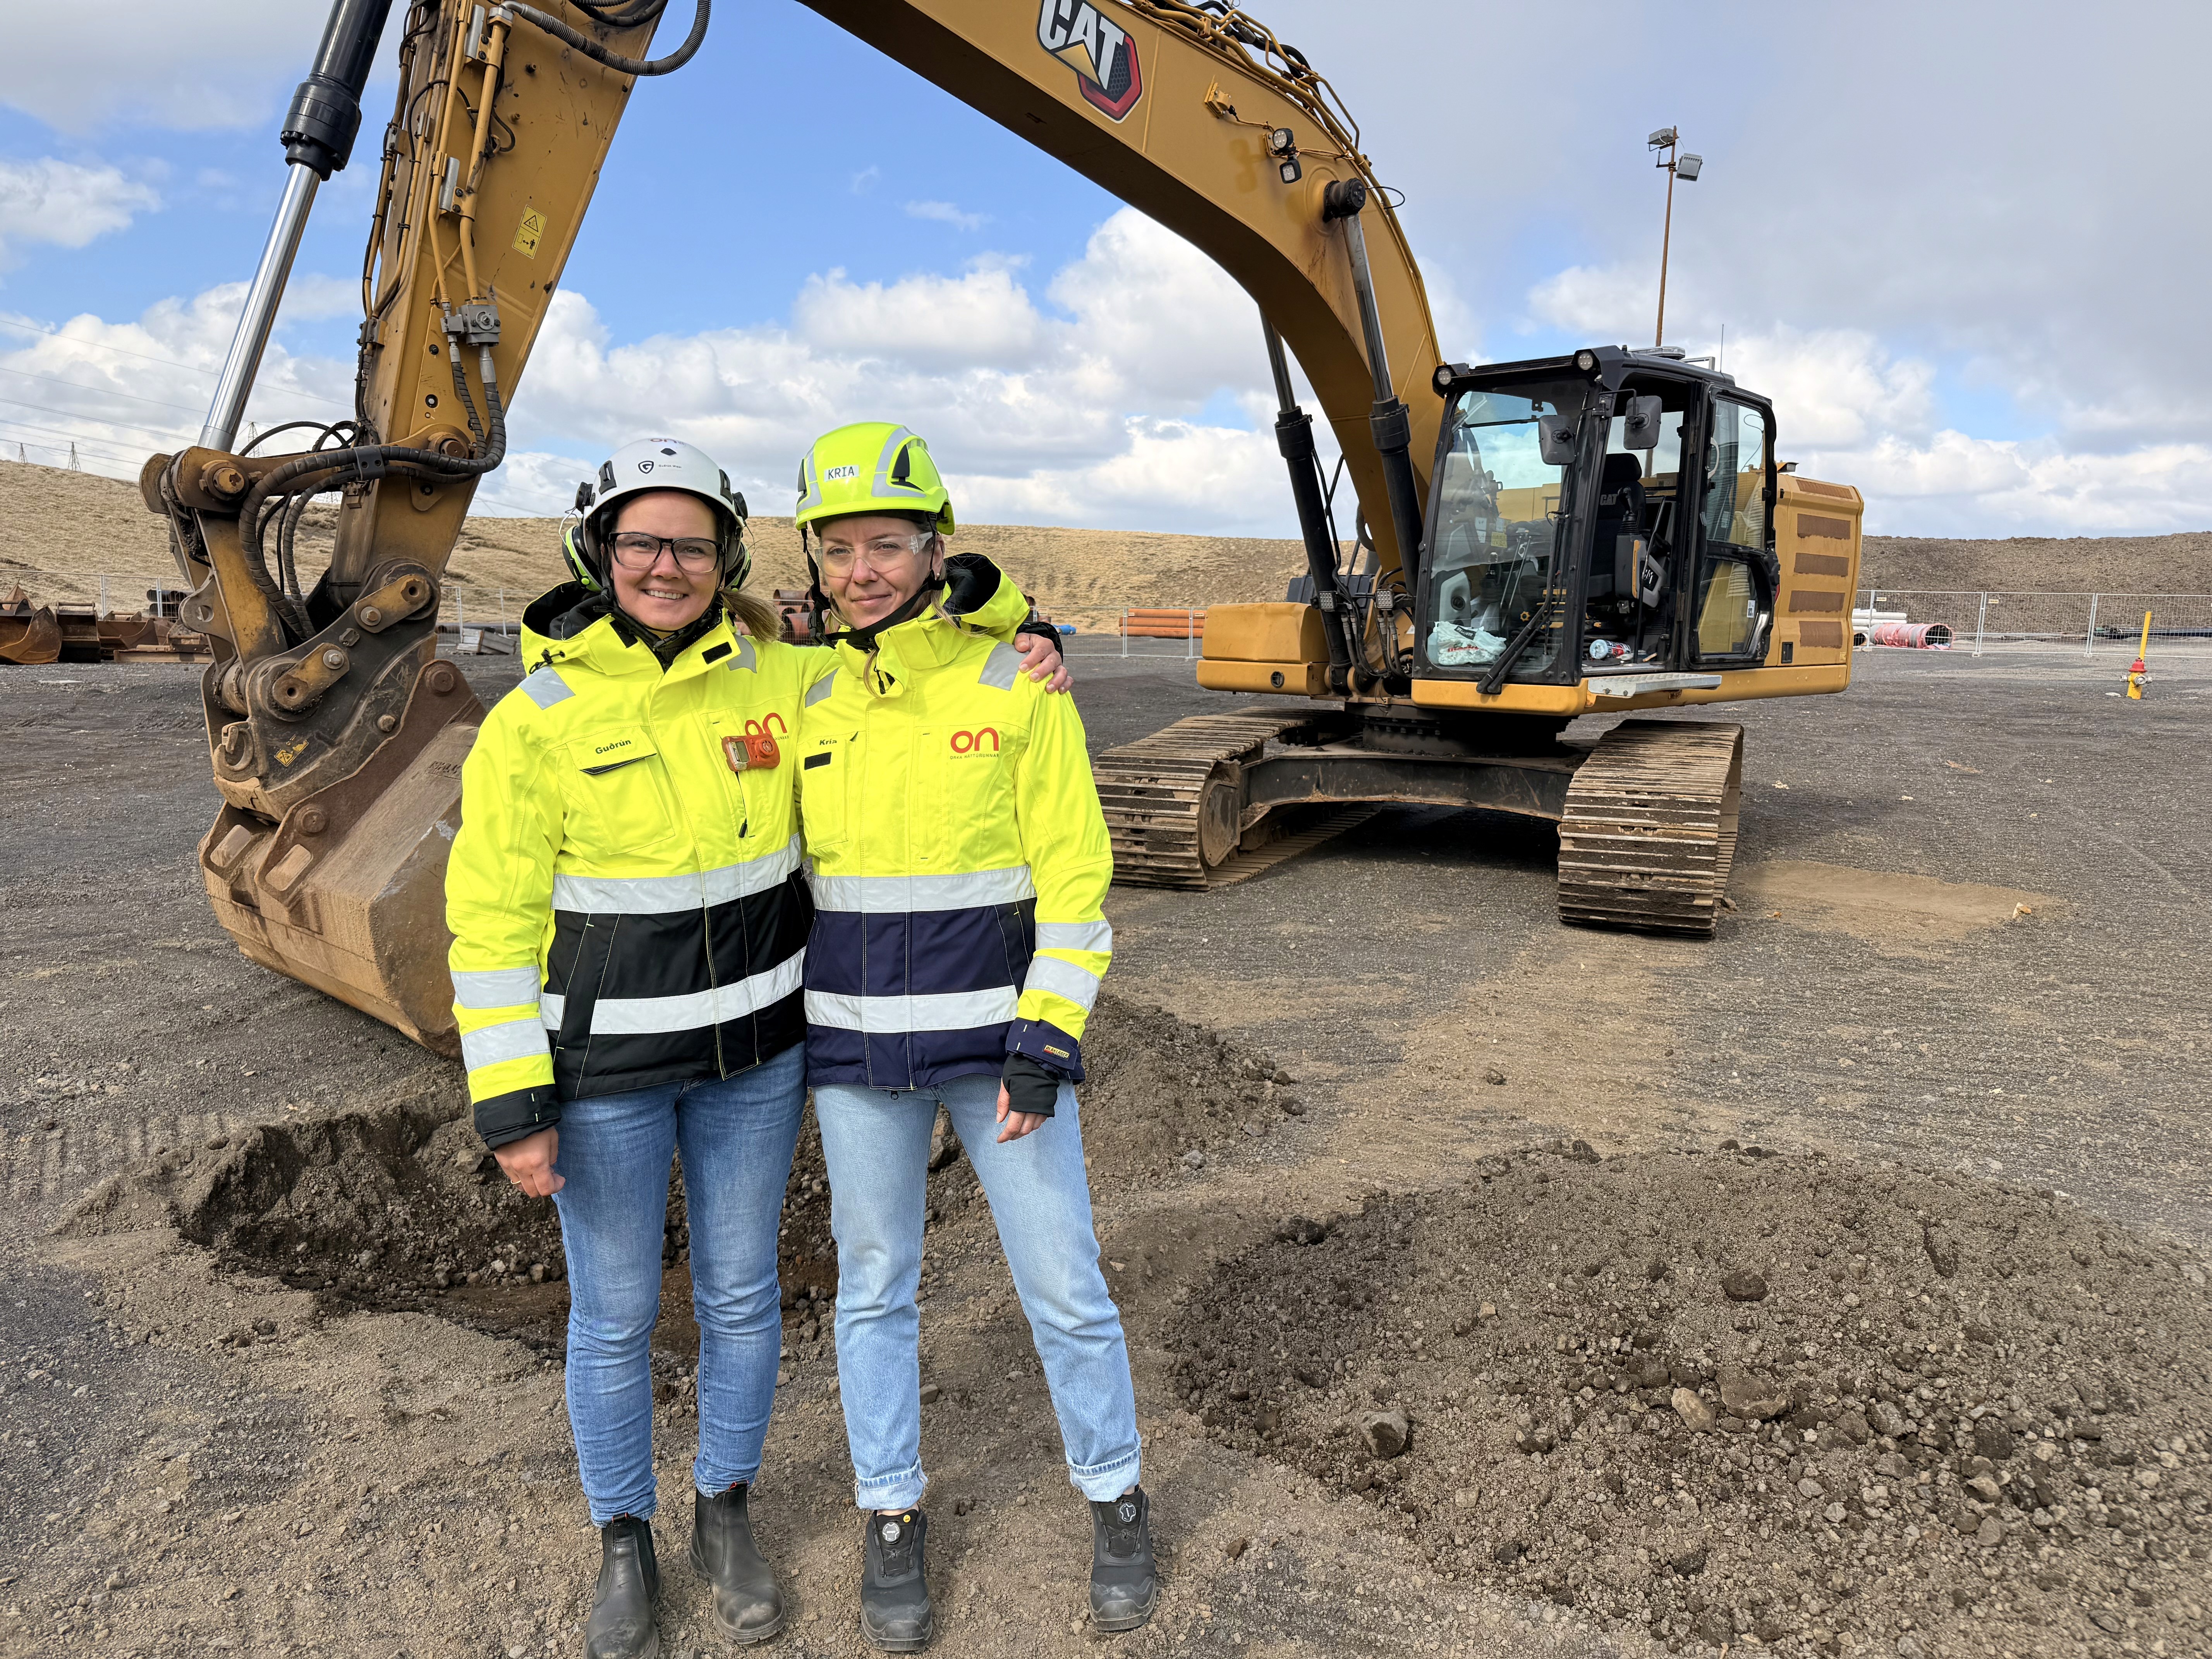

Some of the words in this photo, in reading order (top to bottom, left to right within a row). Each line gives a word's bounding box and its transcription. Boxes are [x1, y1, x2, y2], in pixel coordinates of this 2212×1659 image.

[1039, 0, 1125, 90] CAT
[828, 466, 854, 480] KRIA
[1600, 494, 1618, 505] CAT
[745, 713, 787, 737] on
[595, 740, 631, 754] Guðrún
[950, 727, 999, 754] on
